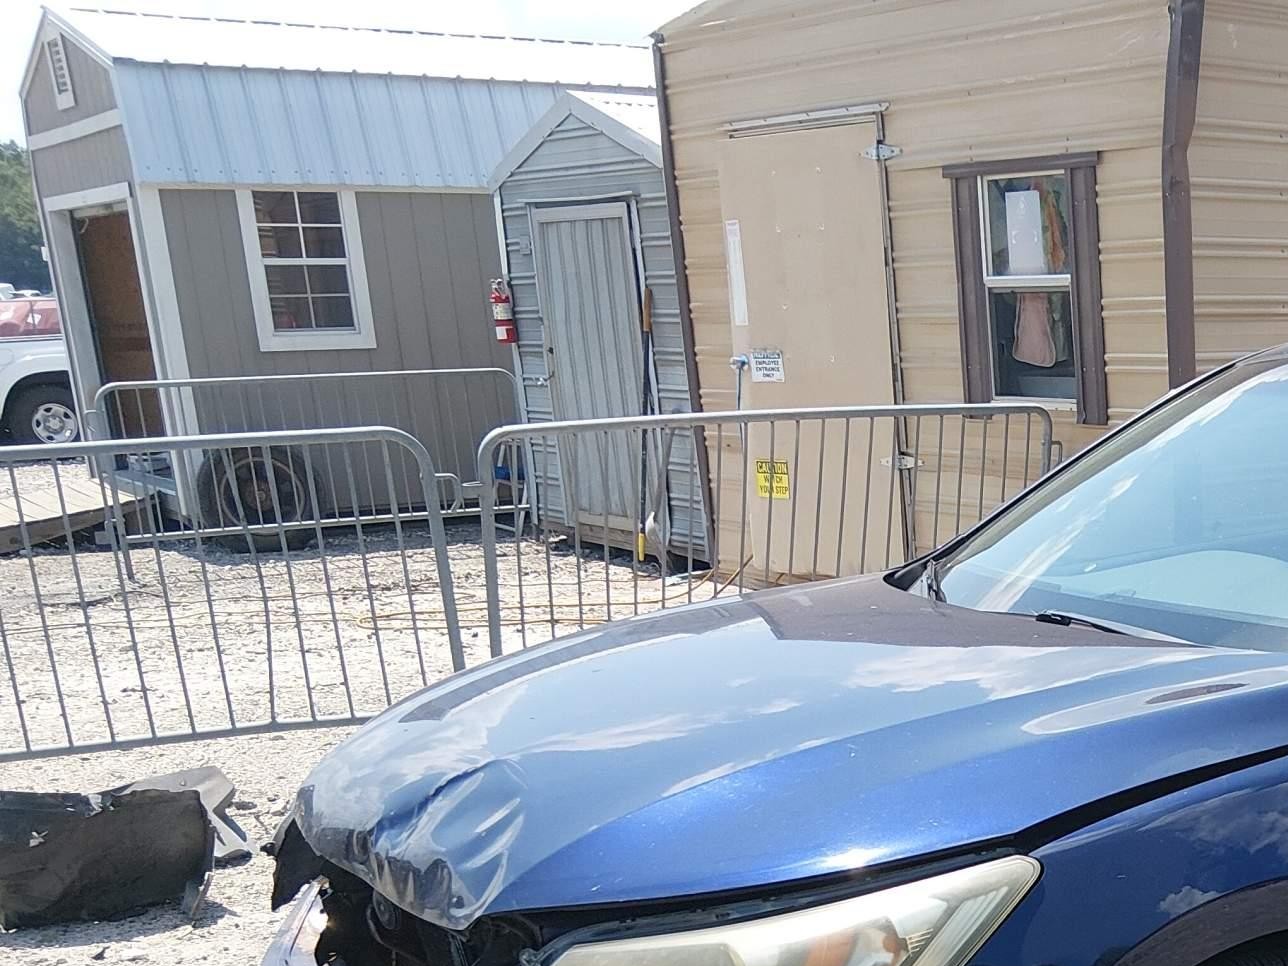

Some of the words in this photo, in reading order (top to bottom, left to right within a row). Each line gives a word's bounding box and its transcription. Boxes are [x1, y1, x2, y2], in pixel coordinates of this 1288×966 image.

[757, 462, 788, 473] CAUION
[763, 475, 783, 483] WCH
[760, 485, 774, 493] YO
[775, 486, 788, 494] STEP
